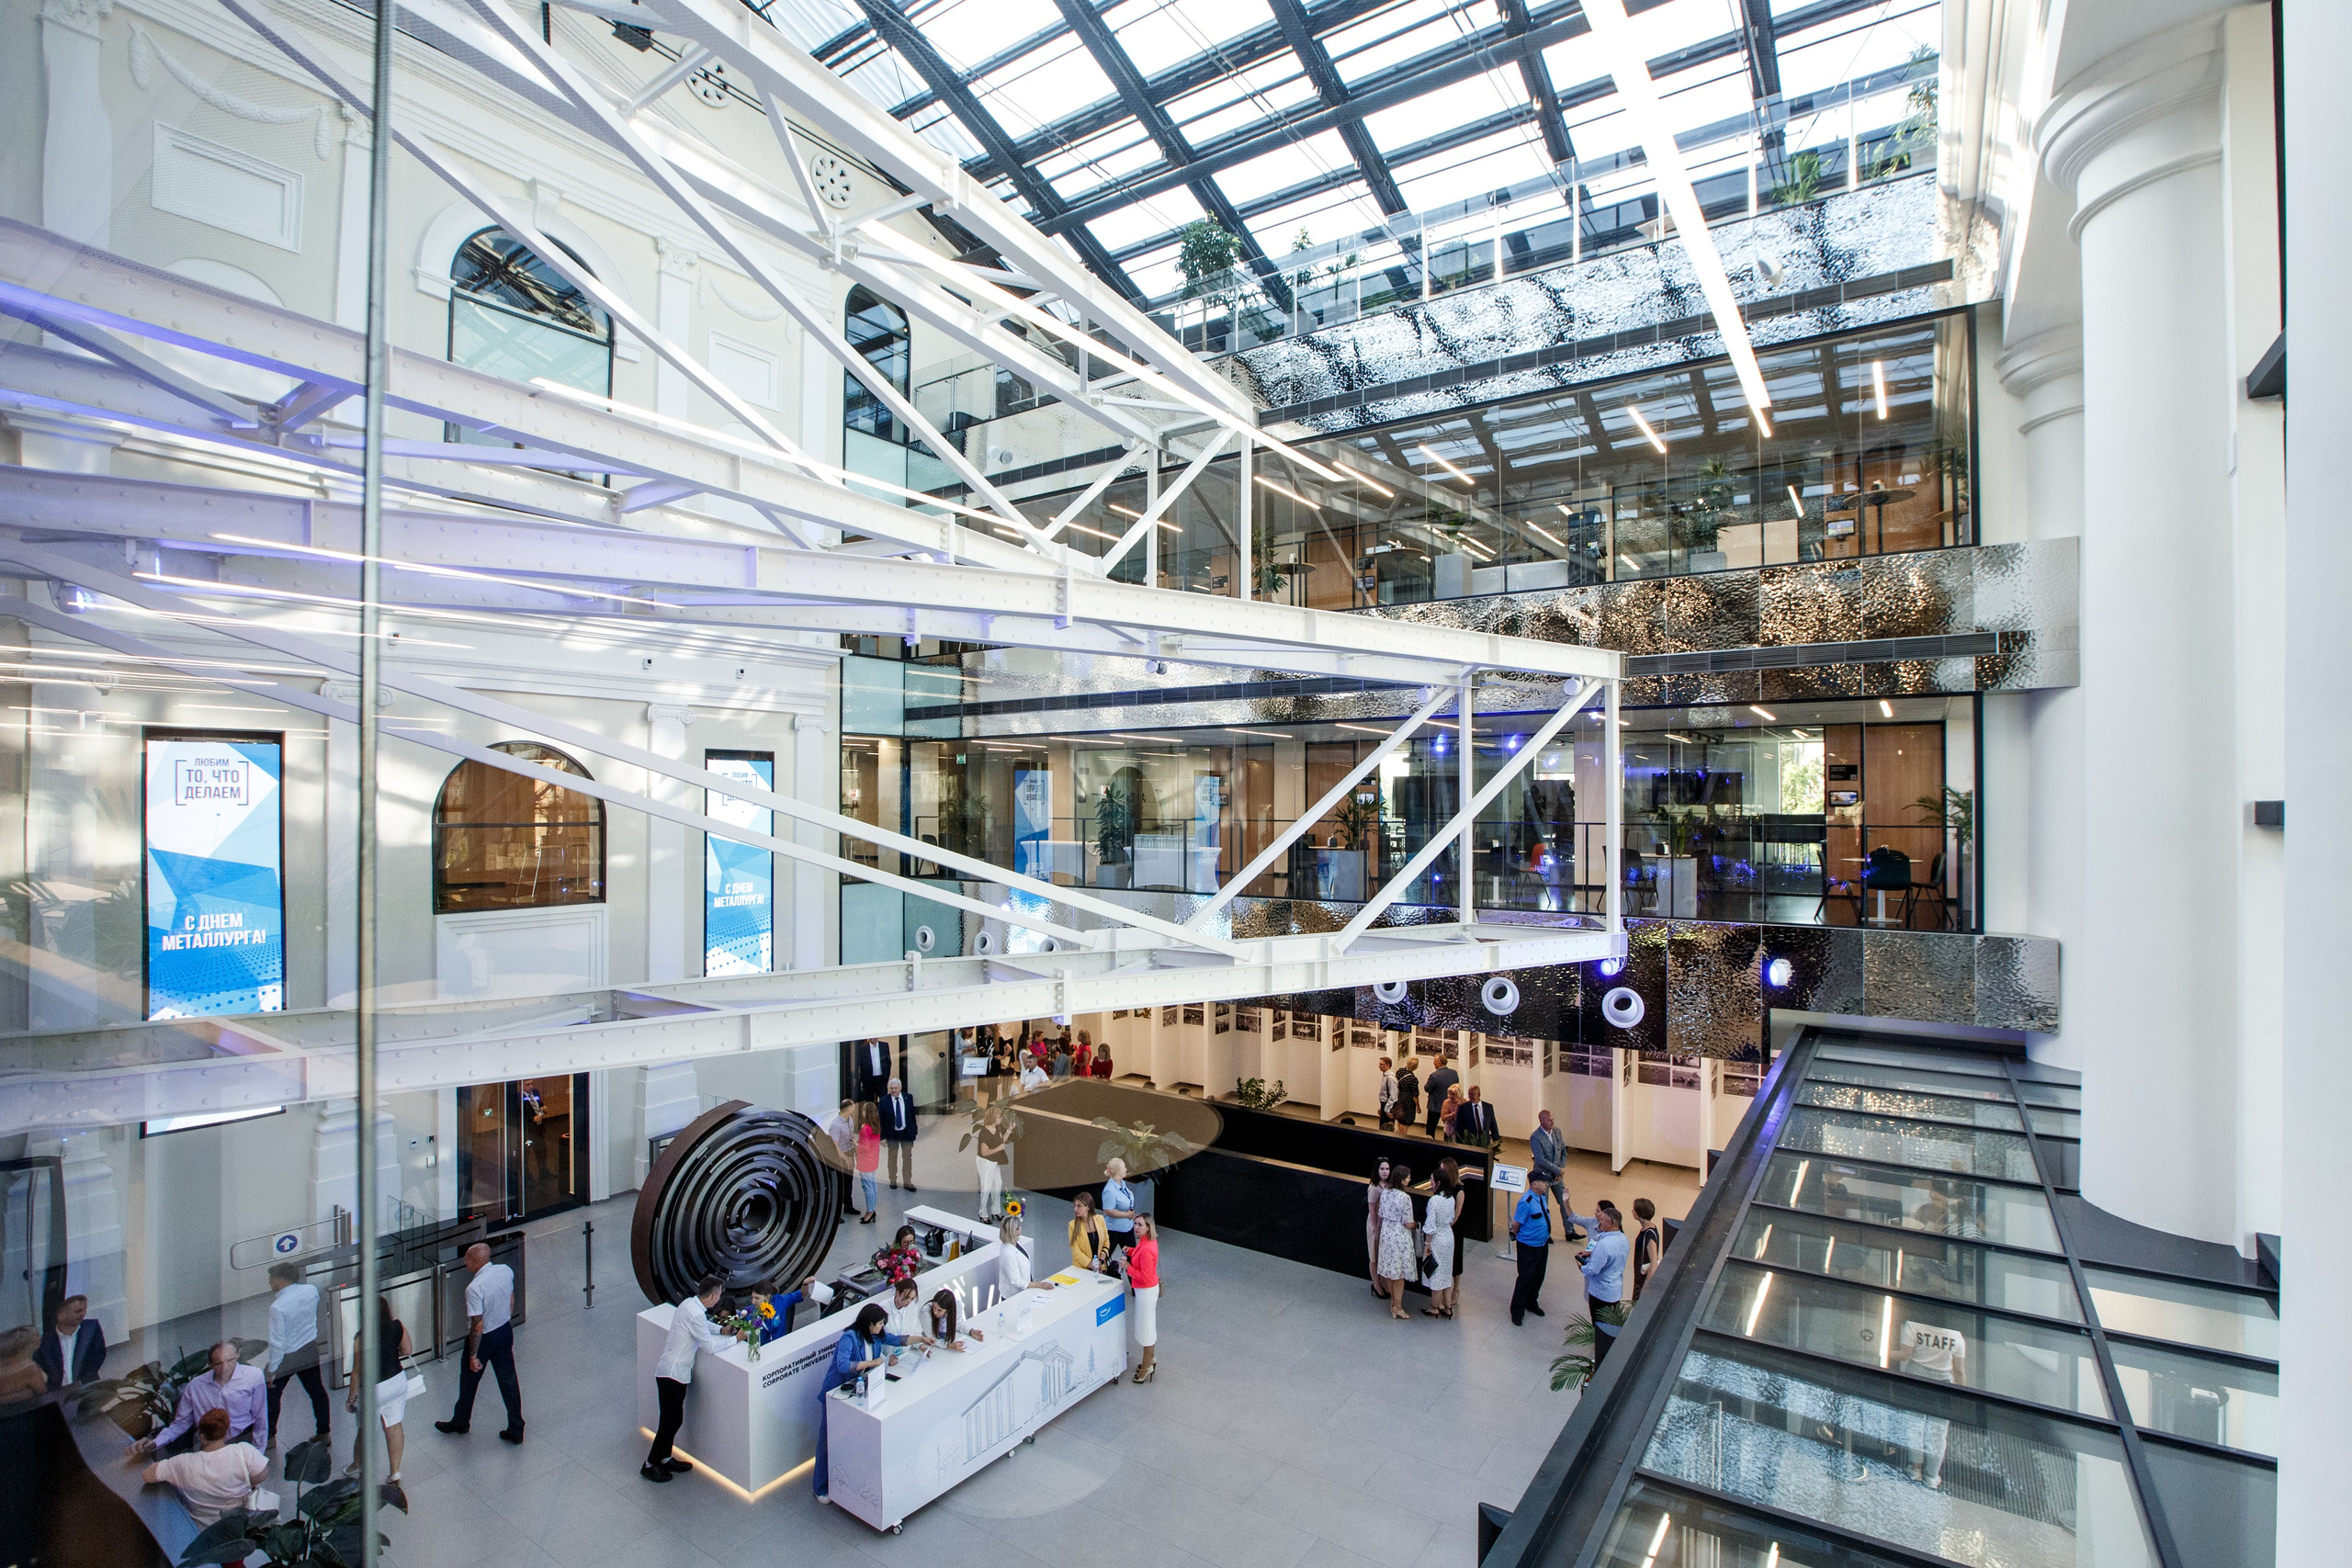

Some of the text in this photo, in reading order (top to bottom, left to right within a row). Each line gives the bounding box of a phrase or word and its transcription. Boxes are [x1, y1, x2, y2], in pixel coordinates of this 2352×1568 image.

[195, 758, 230, 767] ЛЮБИМ
[186, 769, 240, 784] ТО, ЧТО
[185, 786, 241, 800] ДЕЛАЕМ
[725, 882, 753, 896] С ДНЕМ
[713, 893, 764, 908] МЕТАЛЛУРГА!
[184, 912, 243, 932] С ДНЕМ
[162, 929, 266, 952] МЕТАЛЛУРГА!
[1916, 1331, 1956, 1351] STAFF
[762, 1350, 817, 1382] КОРПОРАТИВНЫЙ
[763, 1349, 835, 1389] CORPORATE UNIVERSITY
